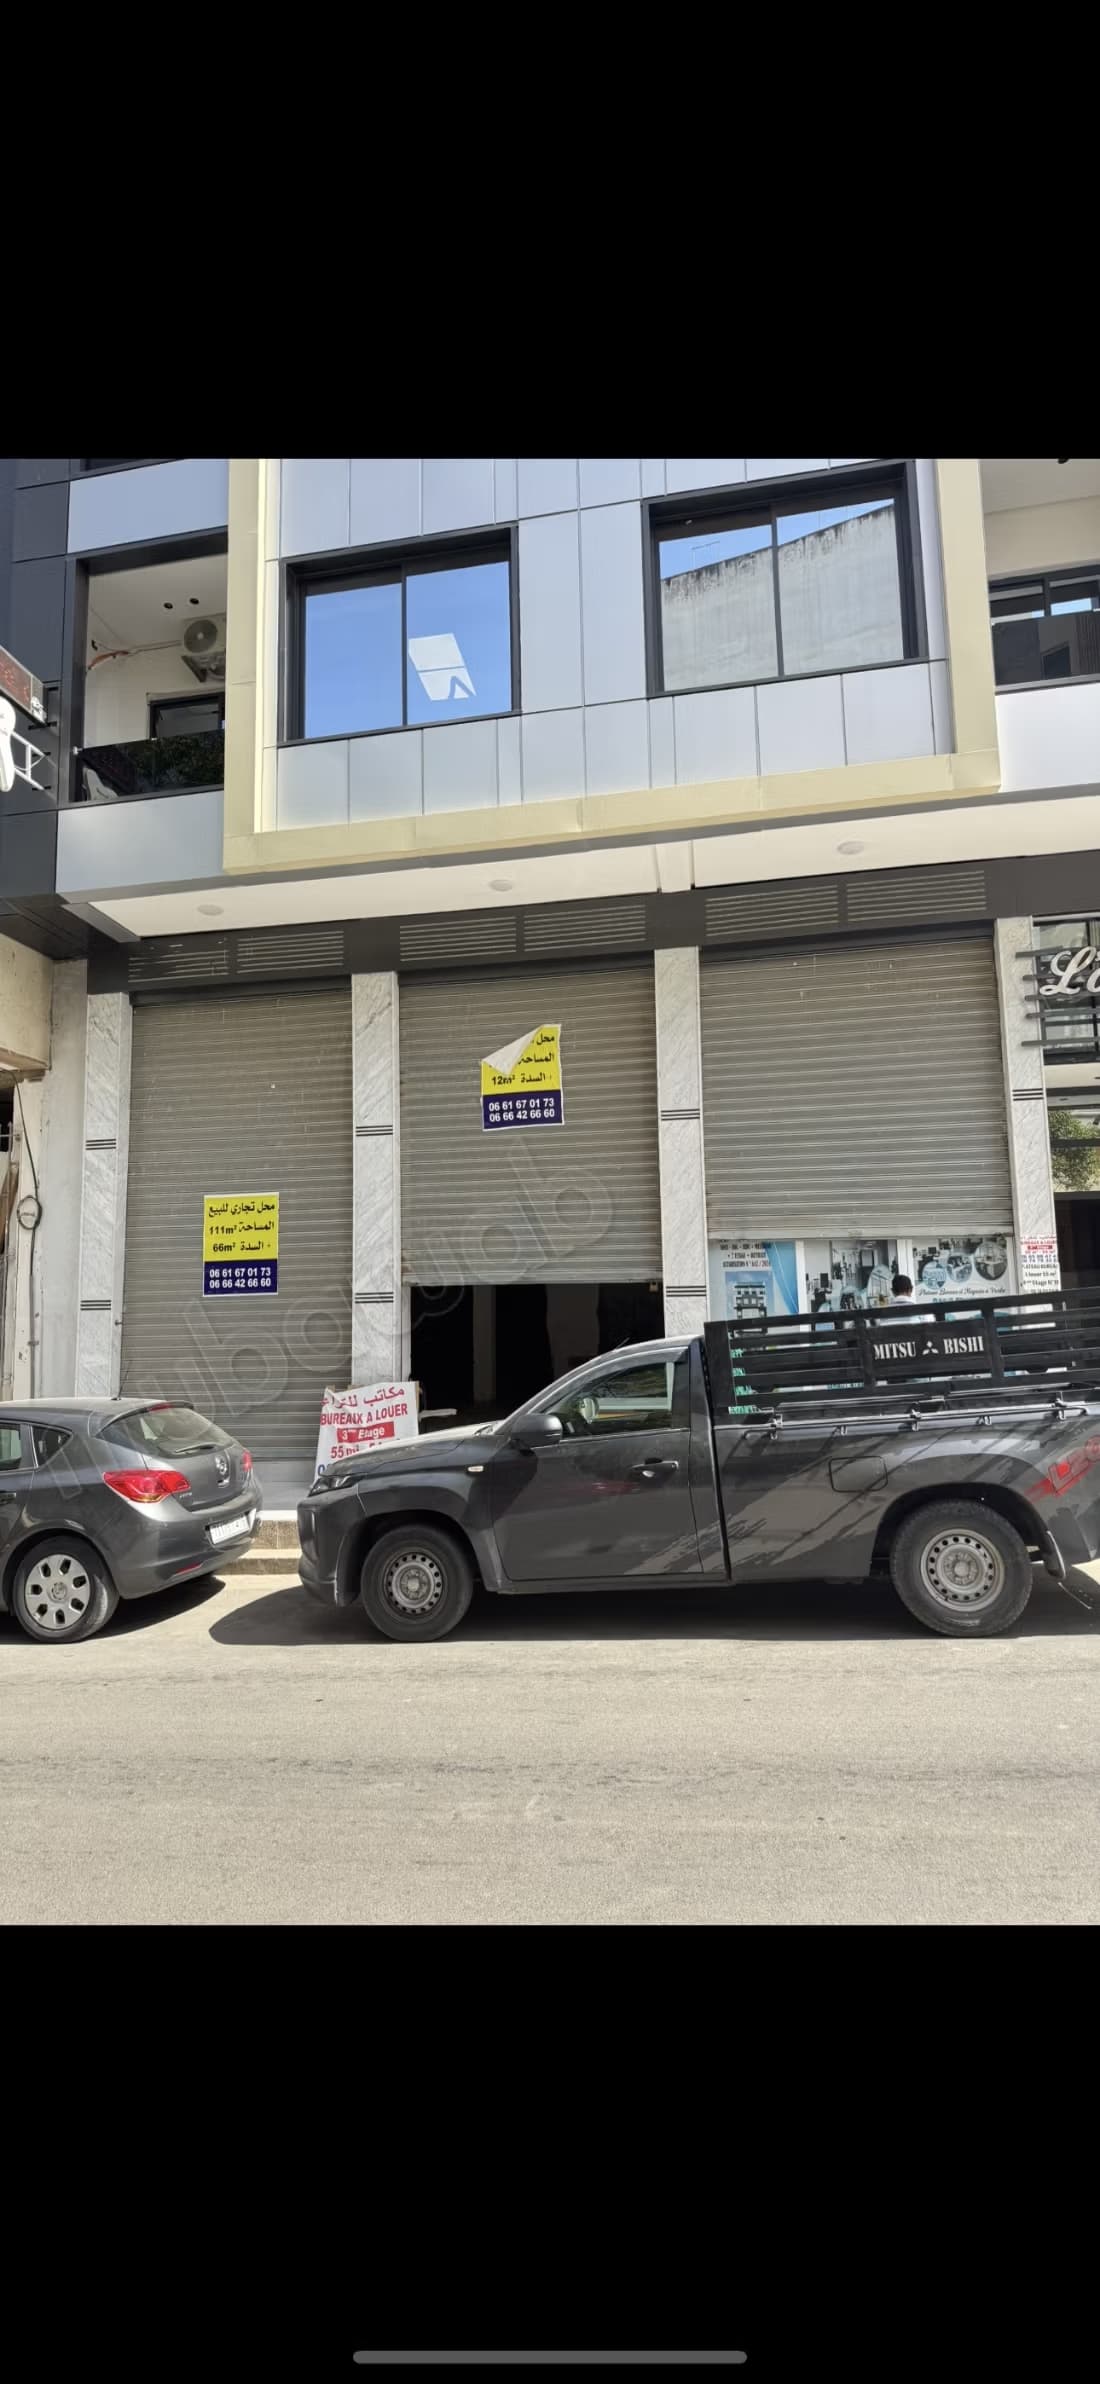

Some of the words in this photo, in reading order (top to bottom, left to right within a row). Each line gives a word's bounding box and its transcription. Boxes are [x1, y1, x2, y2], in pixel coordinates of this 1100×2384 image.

[488, 1102, 501, 1112] 06
[502, 1101, 514, 1110] 61
[516, 1100, 528, 1109] 67
[529, 1099, 541, 1108] 01
[543, 1098, 555, 1107] 73
[489, 1112, 502, 1122] 06
[502, 1111, 515, 1120] 66
[516, 1110, 528, 1119] 42
[529, 1110, 542, 1119] 66
[543, 1109, 556, 1118] 60
[208, 1202, 229, 1217] للبيع
[230, 1201, 255, 1215] تجاري
[257, 1202, 275, 1213] محل
[238, 1221, 275, 1232] المساحة
[240, 1240, 264, 1251] السدة
[209, 1268, 220, 1278] 06
[222, 1268, 232, 1277] 61
[234, 1267, 245, 1277] 67
[247, 1267, 258, 1276] 01
[260, 1266, 271, 1276] 73
[209, 1279, 220, 1289] 06
[222, 1279, 233, 1288] 66
[234, 1278, 246, 1288] 42
[247, 1278, 258, 1287] 66
[260, 1277, 271, 1287] 60
[873, 1341, 917, 1360] MITSU
[943, 1336, 985, 1354] BISHI
[363, 1386, 405, 1407] مكاتب
[366, 1412, 373, 1423] A
[375, 1403, 408, 1420] LOUER
[330, 1446, 344, 1459] 55
